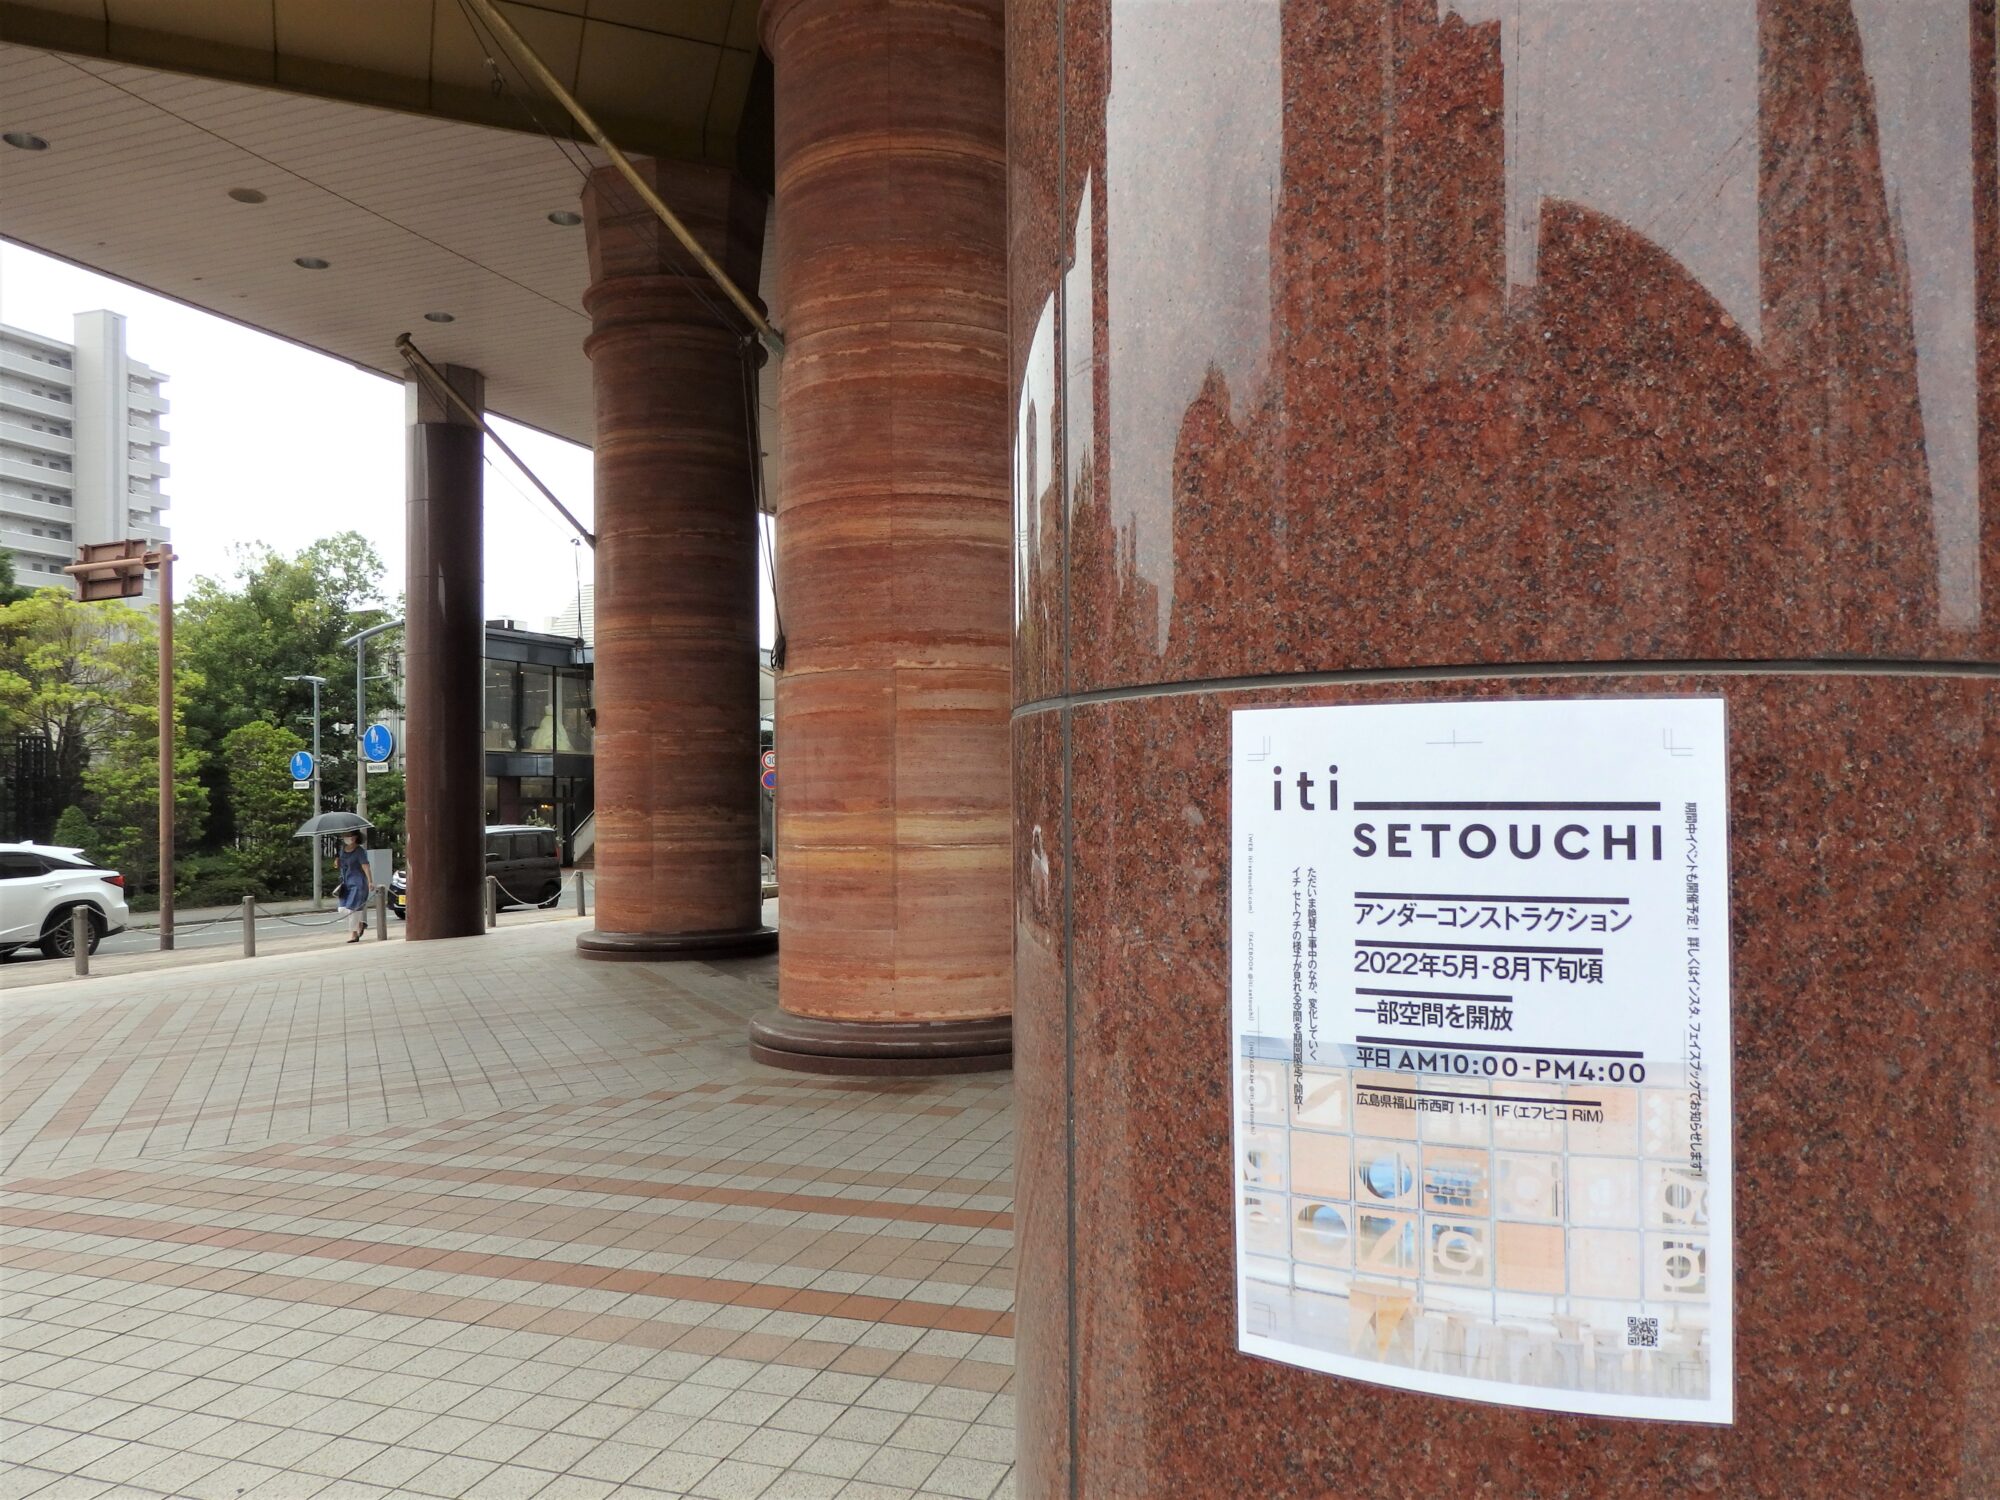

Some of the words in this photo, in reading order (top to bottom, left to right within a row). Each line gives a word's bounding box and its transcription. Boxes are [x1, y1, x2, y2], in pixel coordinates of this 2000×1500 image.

[1273, 765, 1338, 810] iti
[1353, 823, 1662, 861] SETOUCHI
[1354, 903, 1633, 932] アンダーコンストラクション
[1354, 951, 1604, 984] 2022年5月-8月下旬頃
[1355, 1000, 1514, 1031] 一部空間を開放
[1356, 1046, 1391, 1068] 平日
[1398, 1050, 1646, 1083] AM10:00-PM4:00
[1356, 1092, 1454, 1113] 広島県福山市西町
[1459, 1102, 1487, 1115] 1-1-1
